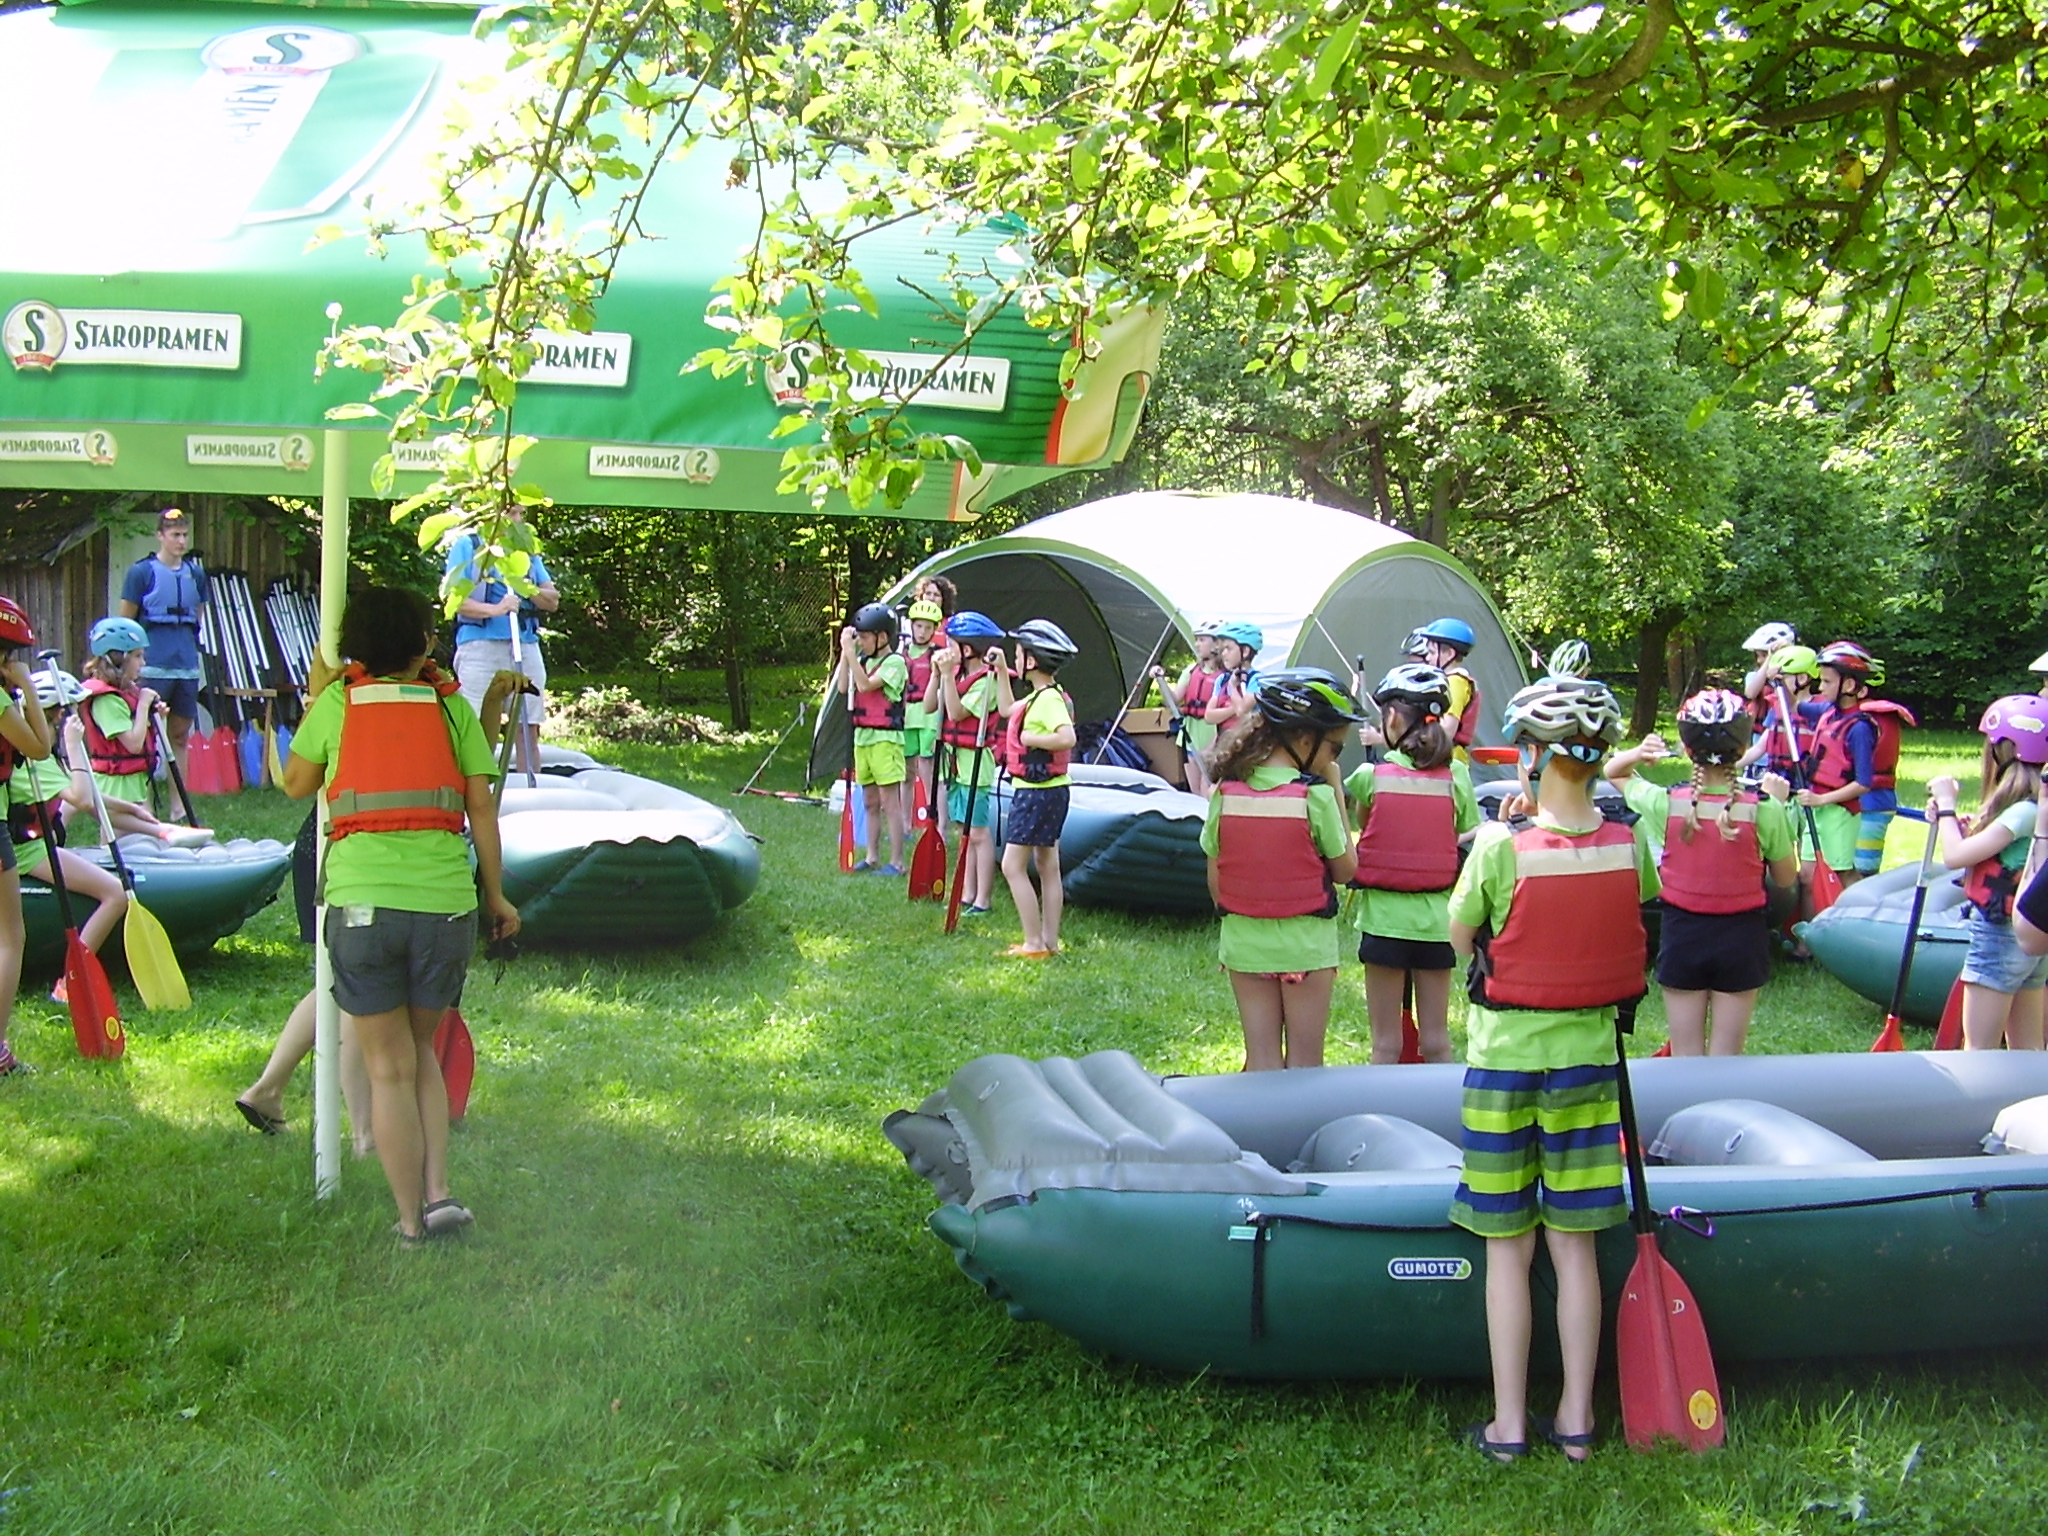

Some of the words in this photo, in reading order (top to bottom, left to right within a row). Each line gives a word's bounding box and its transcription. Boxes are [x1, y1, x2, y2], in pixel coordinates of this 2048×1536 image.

[24, 309, 45, 351] S
[75, 319, 229, 351] STAROPRAMEN
[1394, 1261, 1465, 1276] GUMOTEX
